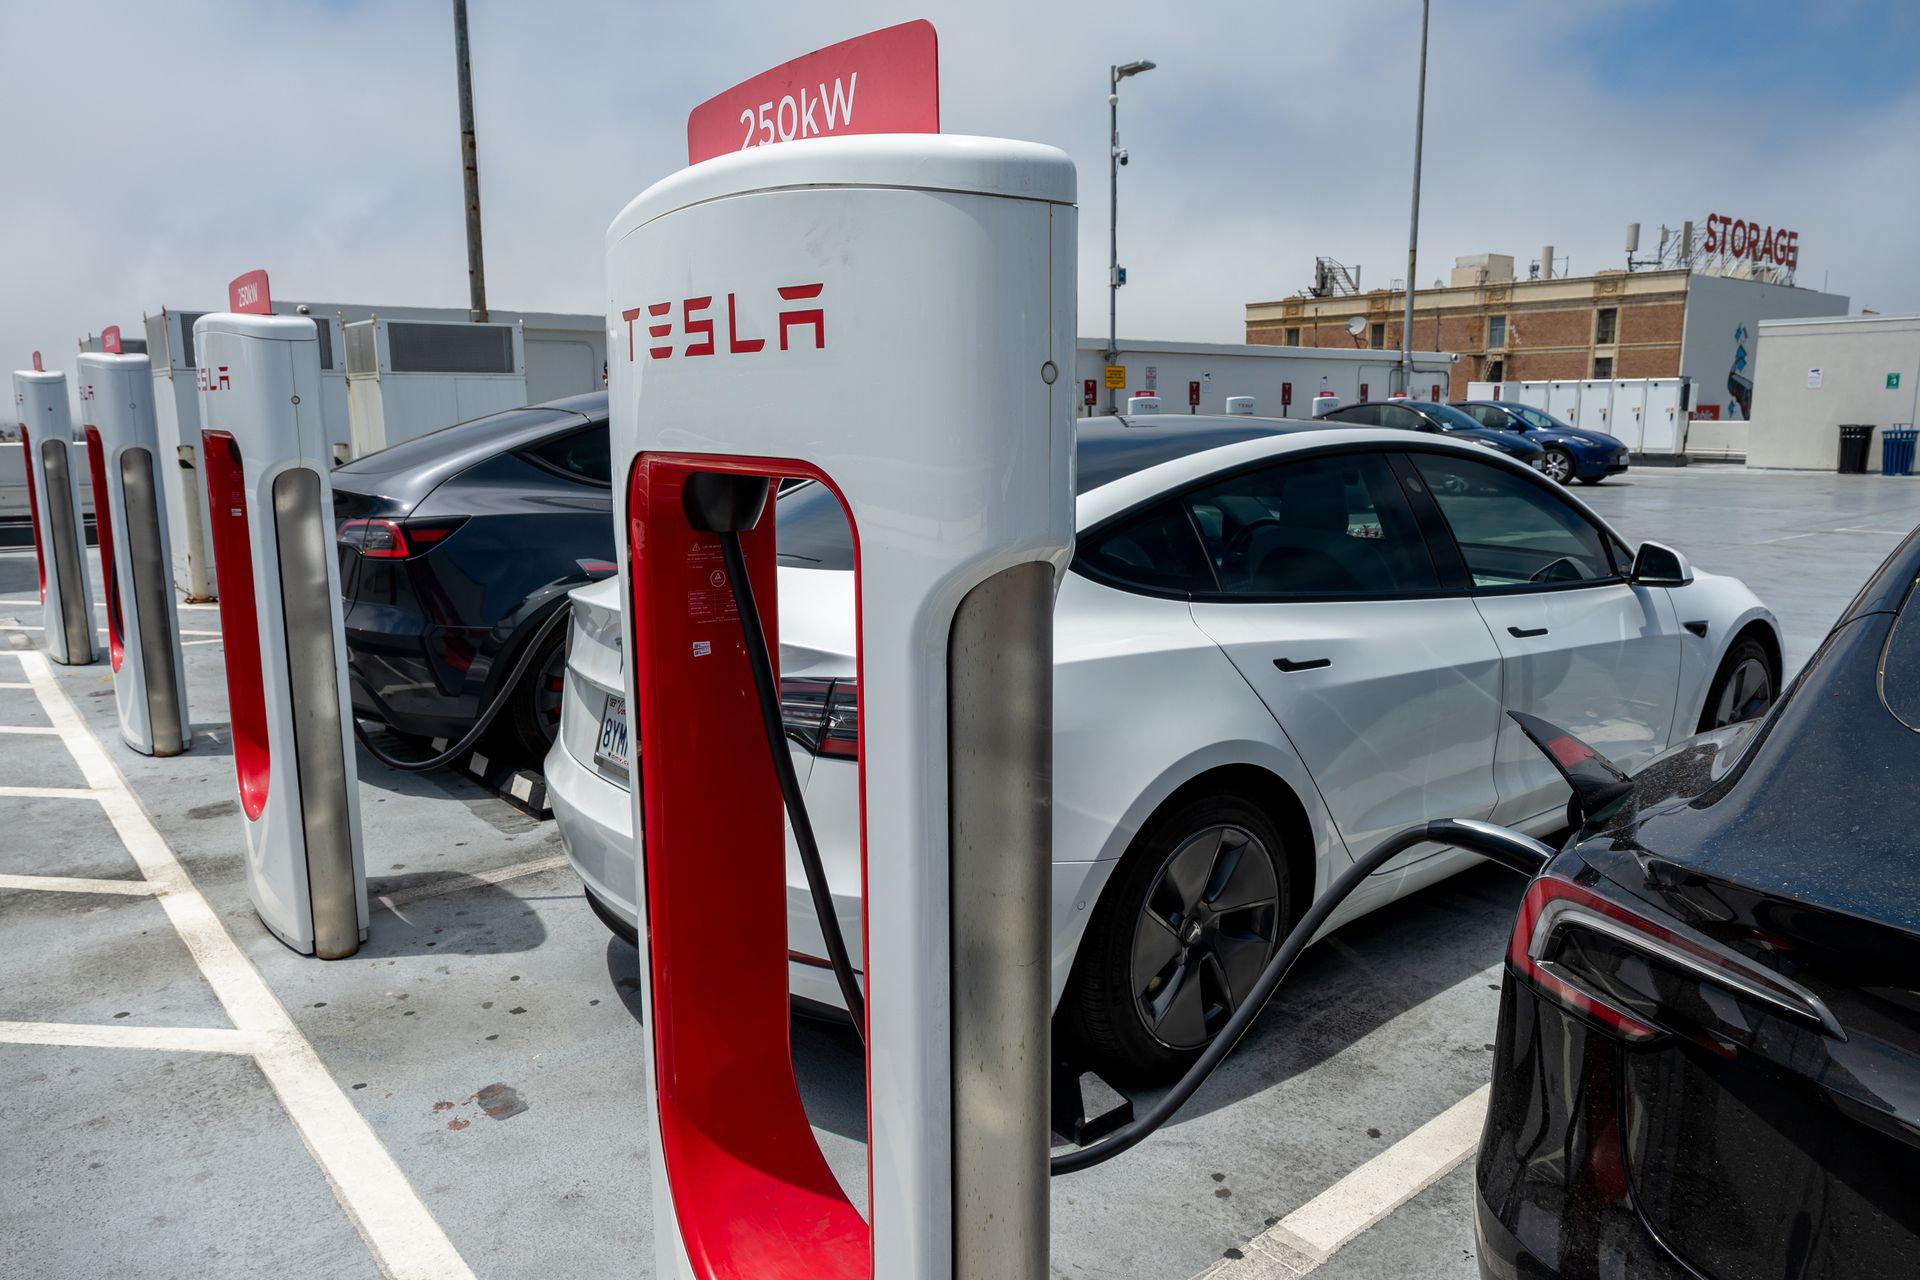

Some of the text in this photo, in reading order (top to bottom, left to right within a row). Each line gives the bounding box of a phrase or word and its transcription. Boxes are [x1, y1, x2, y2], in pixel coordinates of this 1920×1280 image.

[739, 72, 857, 151] 250kW
[1704, 213, 1798, 268] STORAGE
[622, 283, 825, 362] TESLA
[602, 718, 628, 757] 8YM
